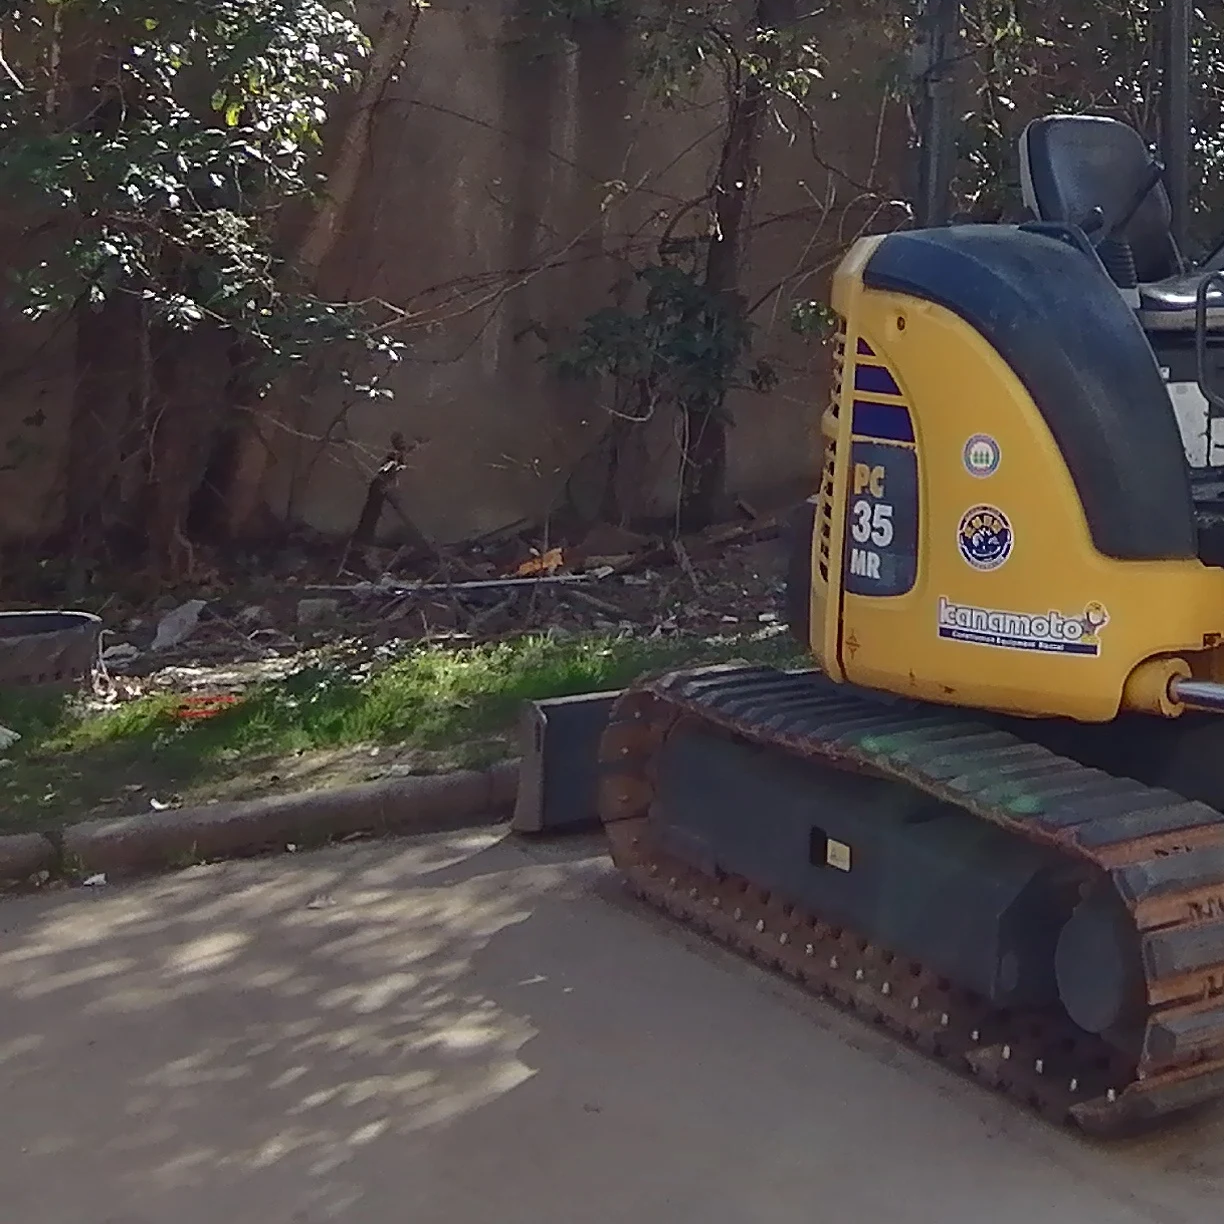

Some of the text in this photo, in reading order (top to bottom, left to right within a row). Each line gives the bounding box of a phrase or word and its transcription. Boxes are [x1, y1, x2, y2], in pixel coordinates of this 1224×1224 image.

[854, 463, 885, 498] PC
[852, 500, 893, 547] 35
[850, 548, 881, 579] MR
[939, 596, 1083, 640] kanamoto
